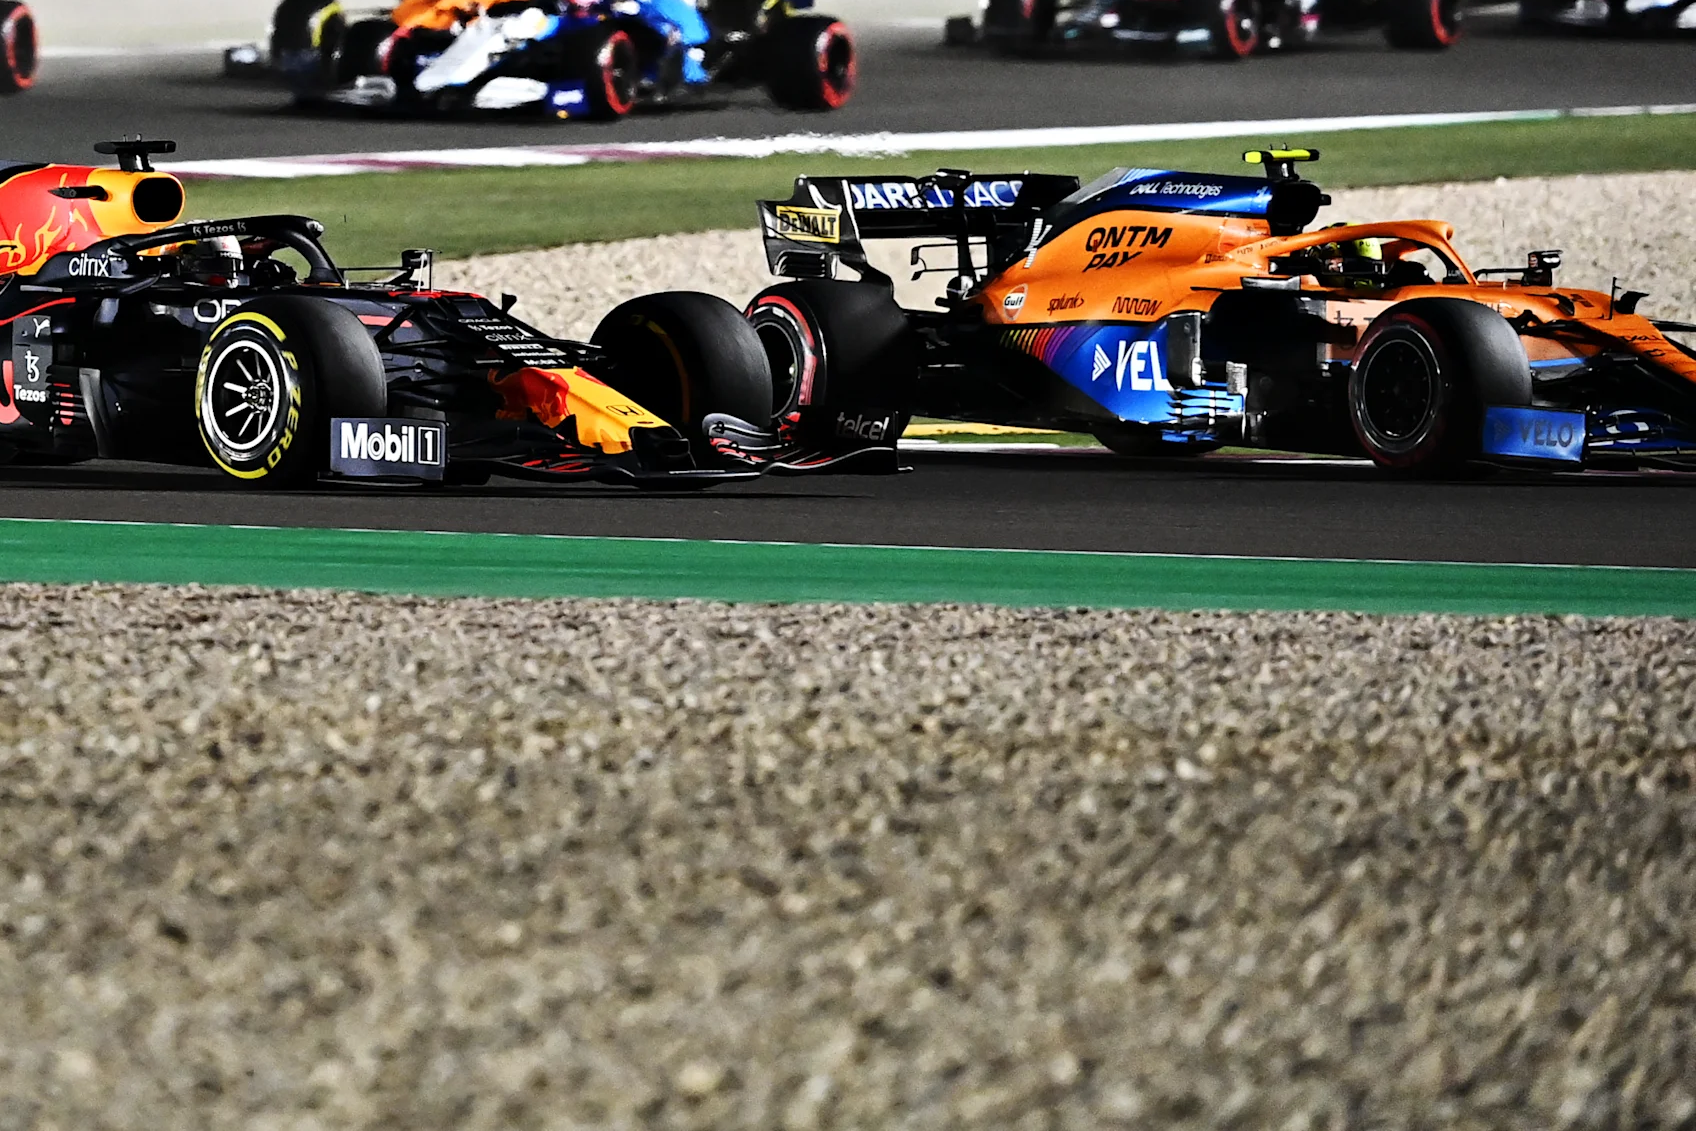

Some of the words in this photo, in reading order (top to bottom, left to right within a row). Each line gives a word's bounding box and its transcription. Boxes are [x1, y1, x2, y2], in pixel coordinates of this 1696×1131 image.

[1159, 181, 1223, 199] Technologies
[203, 224, 235, 235] Tezos
[1085, 226, 1173, 253] QNTM
[68, 253, 109, 277] citrix
[1082, 251, 1143, 273] PAY
[1004, 295, 1024, 306] Gulf
[14, 385, 46, 403] Tezos
[340, 422, 415, 463] Mobil
[1518, 419, 1574, 448] VELO
